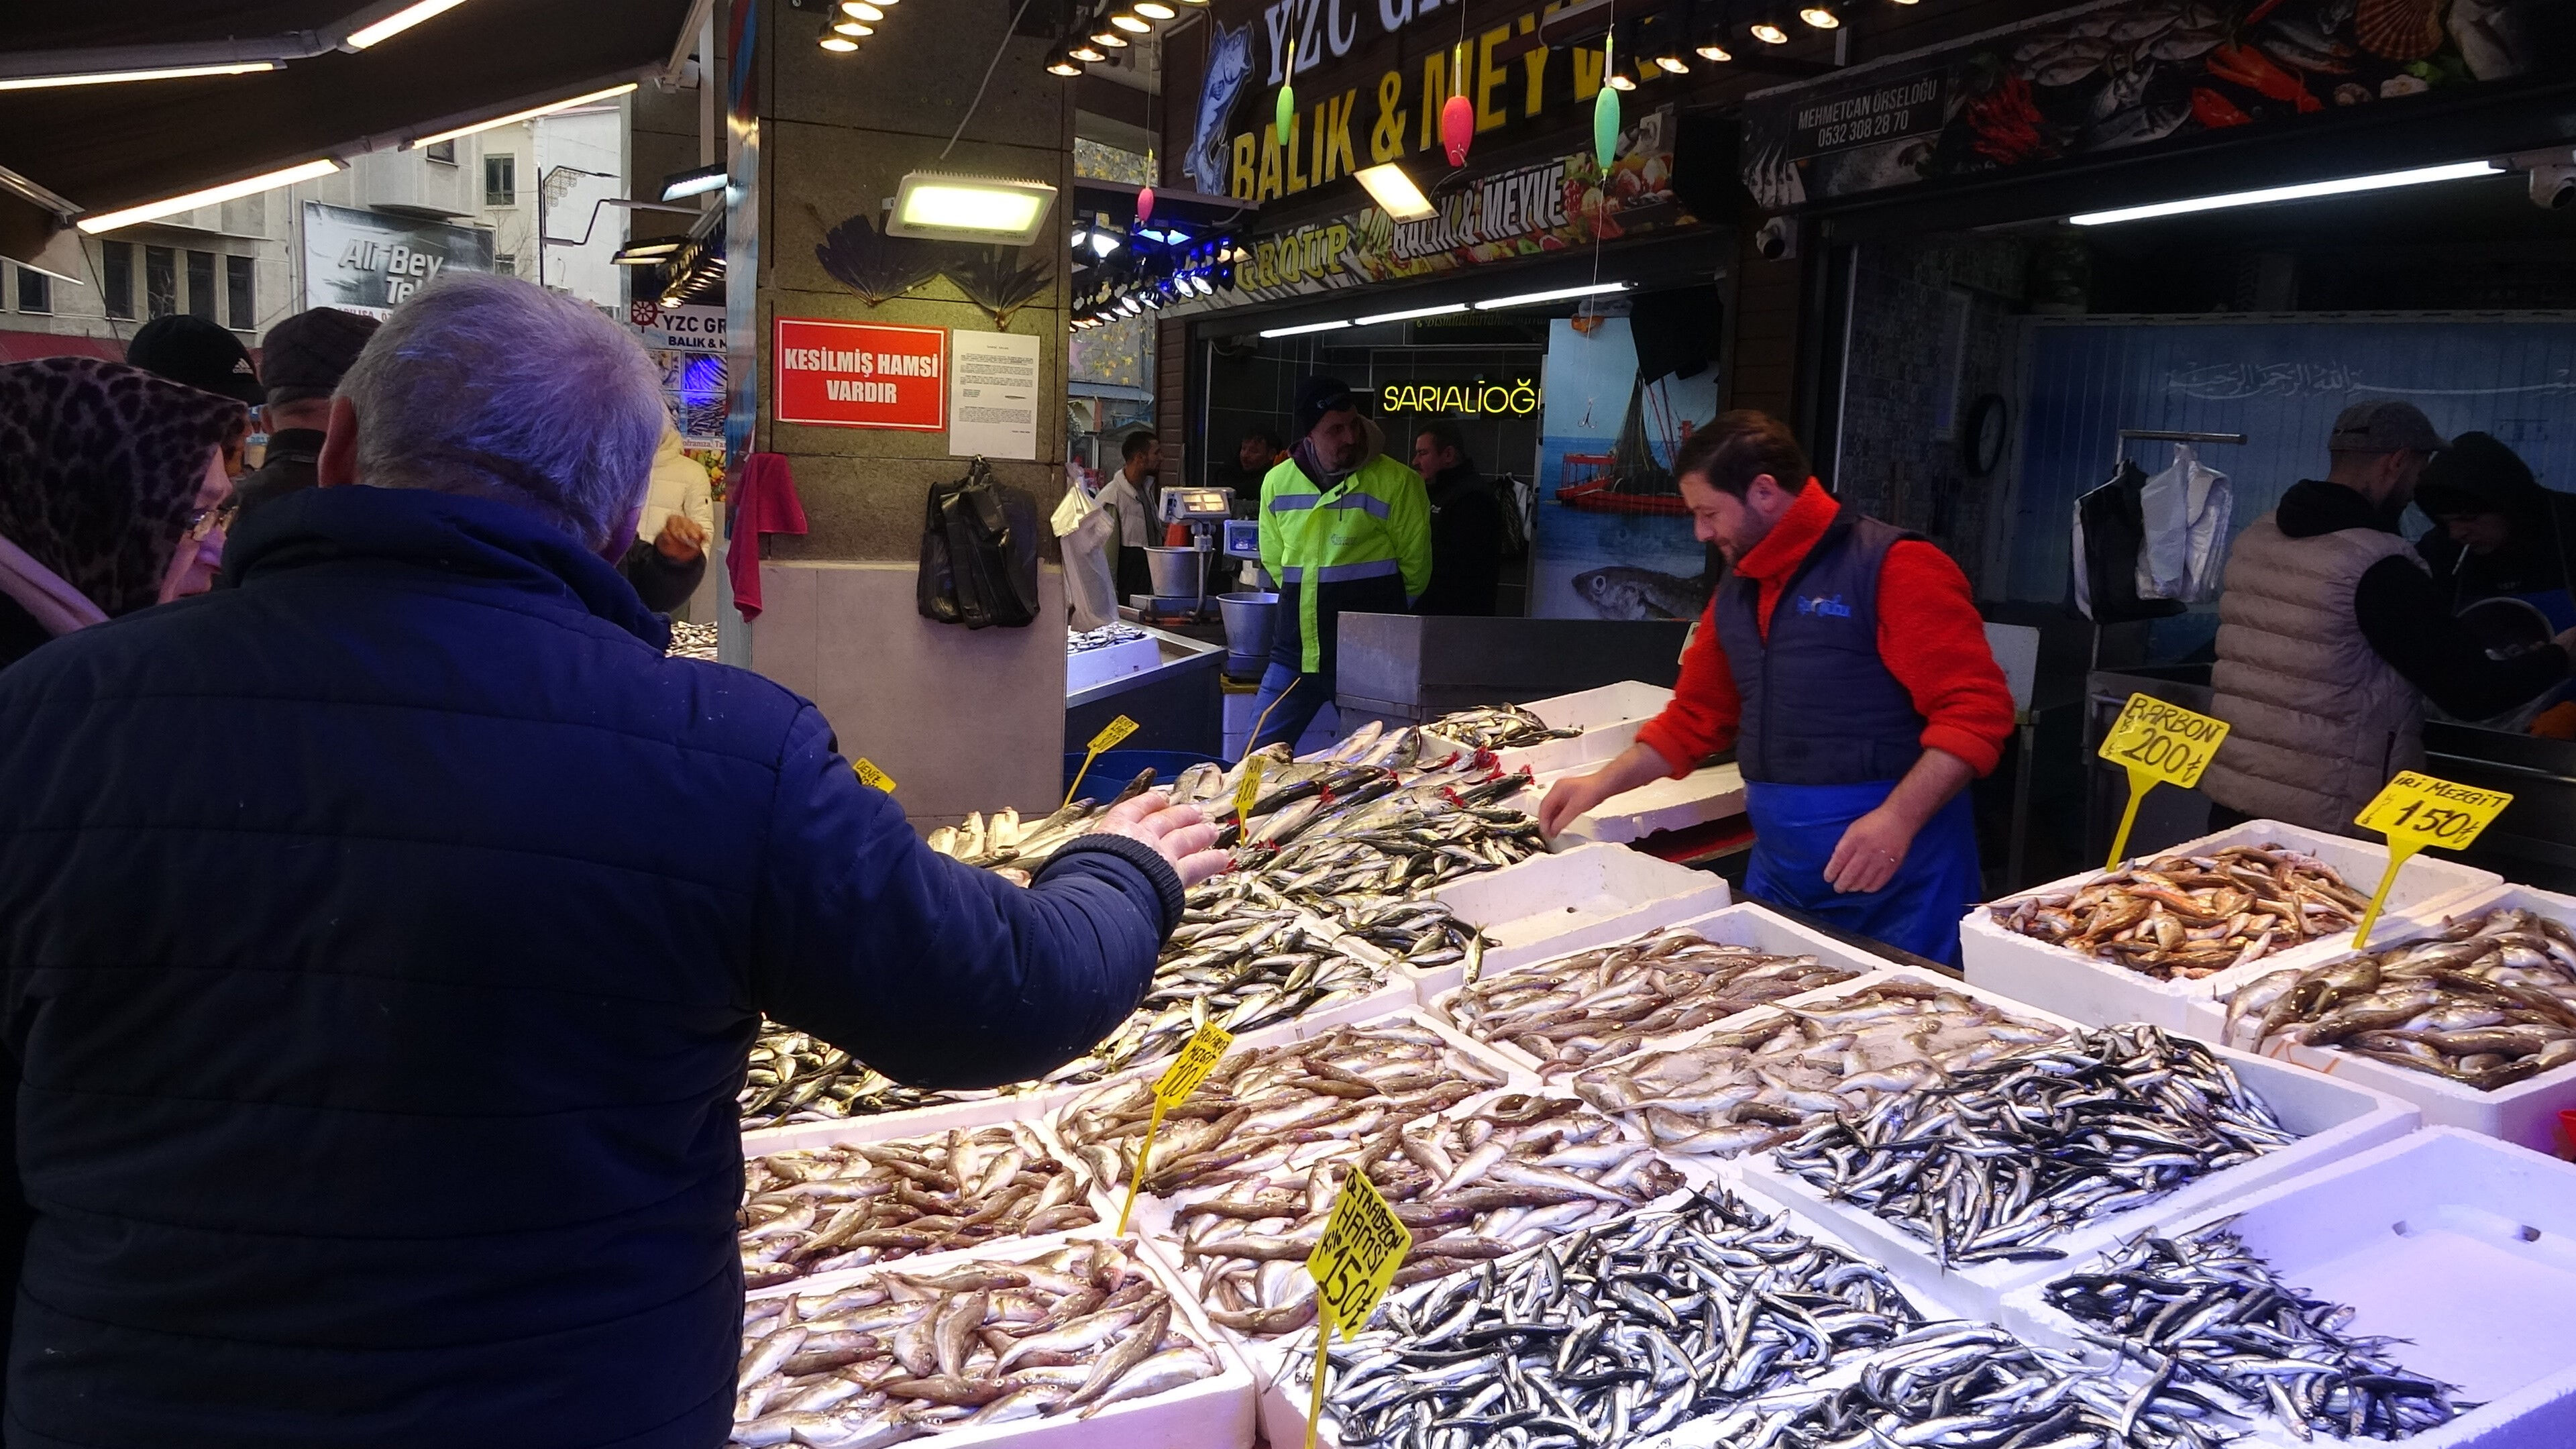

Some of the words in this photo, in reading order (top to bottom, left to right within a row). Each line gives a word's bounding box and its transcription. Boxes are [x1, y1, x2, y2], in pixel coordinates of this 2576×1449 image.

[1798, 95, 1871, 131] MEHMETCAN
[1818, 123, 1846, 148] 0532
[1849, 117, 1872, 141] 308
[1874, 113, 1890, 136] 28
[1893, 109, 1909, 132] 70
[1232, 88, 1356, 203] BALIK
[1371, 70, 1406, 164] &
[1236, 224, 1348, 292] GROUP
[1458, 189, 1481, 246] &
[1481, 164, 1569, 241] MEYVE
[338, 238, 376, 270] Ali
[387, 244, 444, 282] Bey
[662, 315, 699, 332] YZC
[668, 336, 705, 347] BALIK
[708, 338, 717, 348] &
[785, 346, 873, 378] KESİLMİŞ
[877, 353, 938, 378] HAMSİ
[826, 380, 898, 404] VARDIR
[2126, 697, 2223, 743] BARBON
[1356, 1182, 1405, 1250] TRABZON
[1336, 1197, 1389, 1277] HAMSİ
